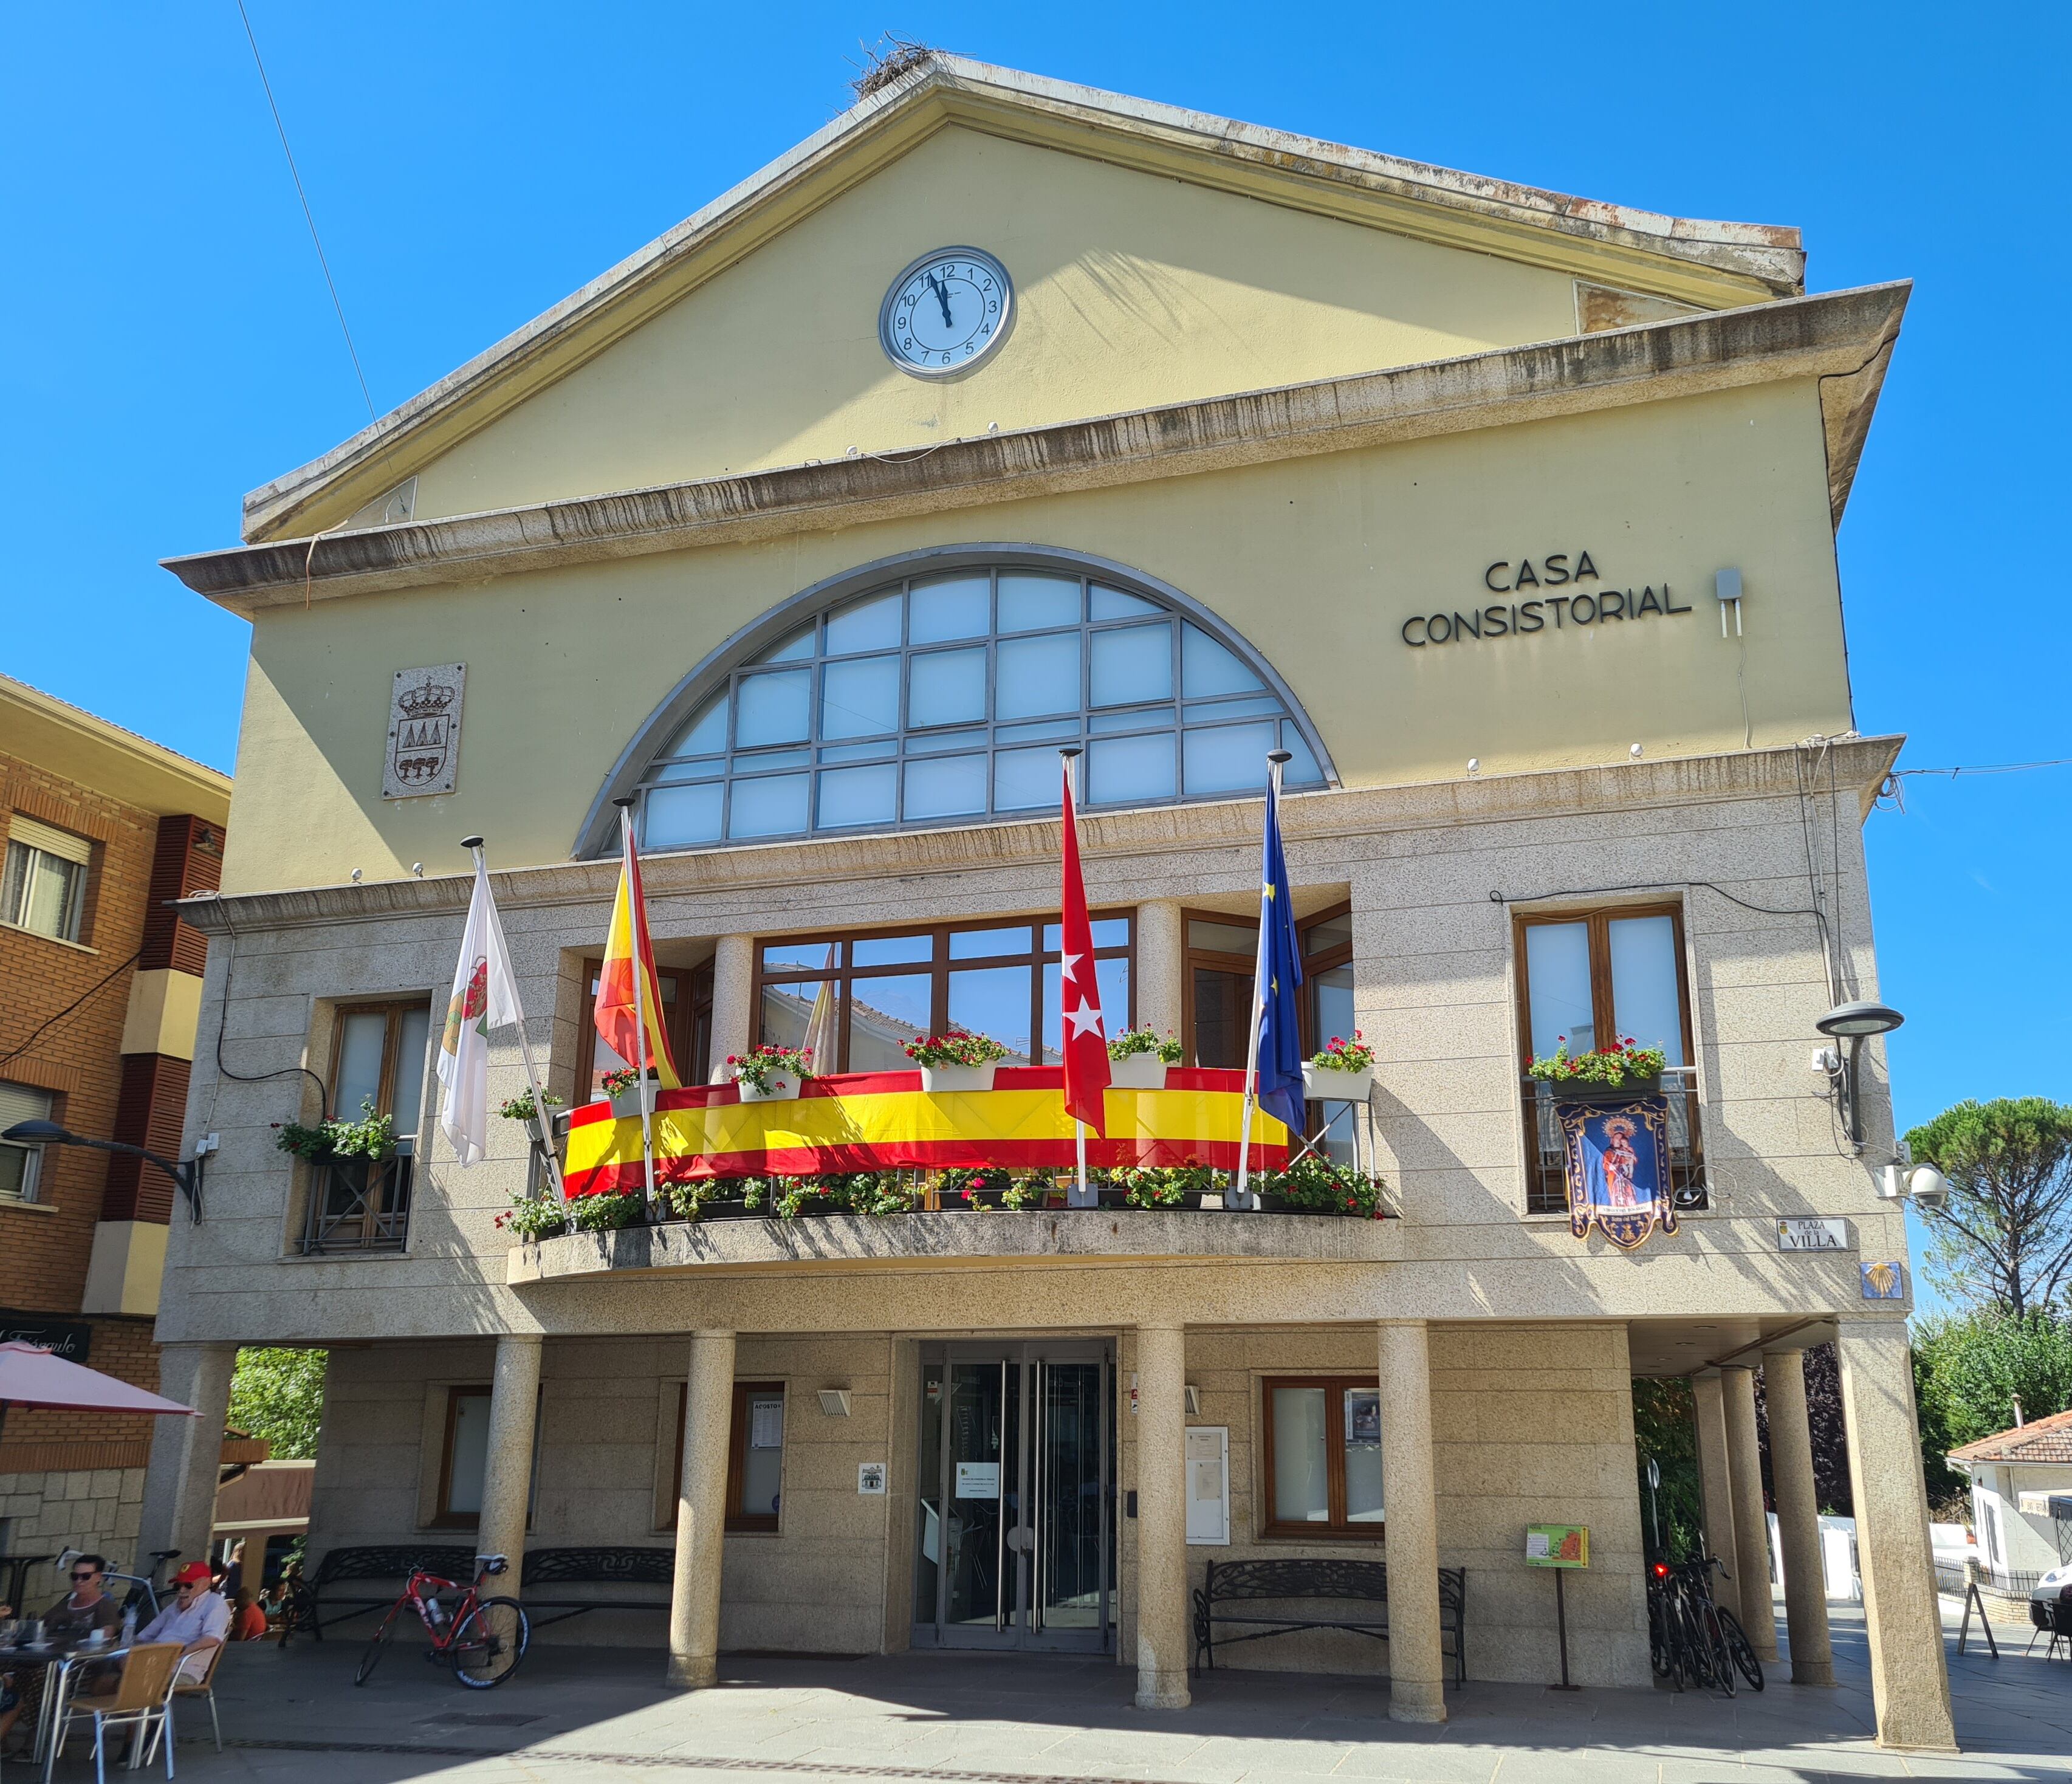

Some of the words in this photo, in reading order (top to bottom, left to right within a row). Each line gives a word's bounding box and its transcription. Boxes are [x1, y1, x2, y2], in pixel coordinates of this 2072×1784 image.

[940, 265, 955, 278] 12
[967, 267, 973, 280] 1
[918, 275, 931, 288] 11
[983, 278, 992, 292] 2
[902, 294, 916, 307] 10
[988, 300, 997, 313] 3
[897, 317, 907, 329] 9
[981, 323, 990, 335] 4
[904, 337, 912, 350] 8
[965, 342, 974, 354] 5
[921, 351, 930, 363] 7
[942, 352, 951, 365] 6
[1485, 551, 1599, 592] CASA
[1402, 583, 1693, 647] CONSISTORIAL
[1798, 1221, 1825, 1229] PLAZA
[1789, 1235, 1837, 1247] VILLA
